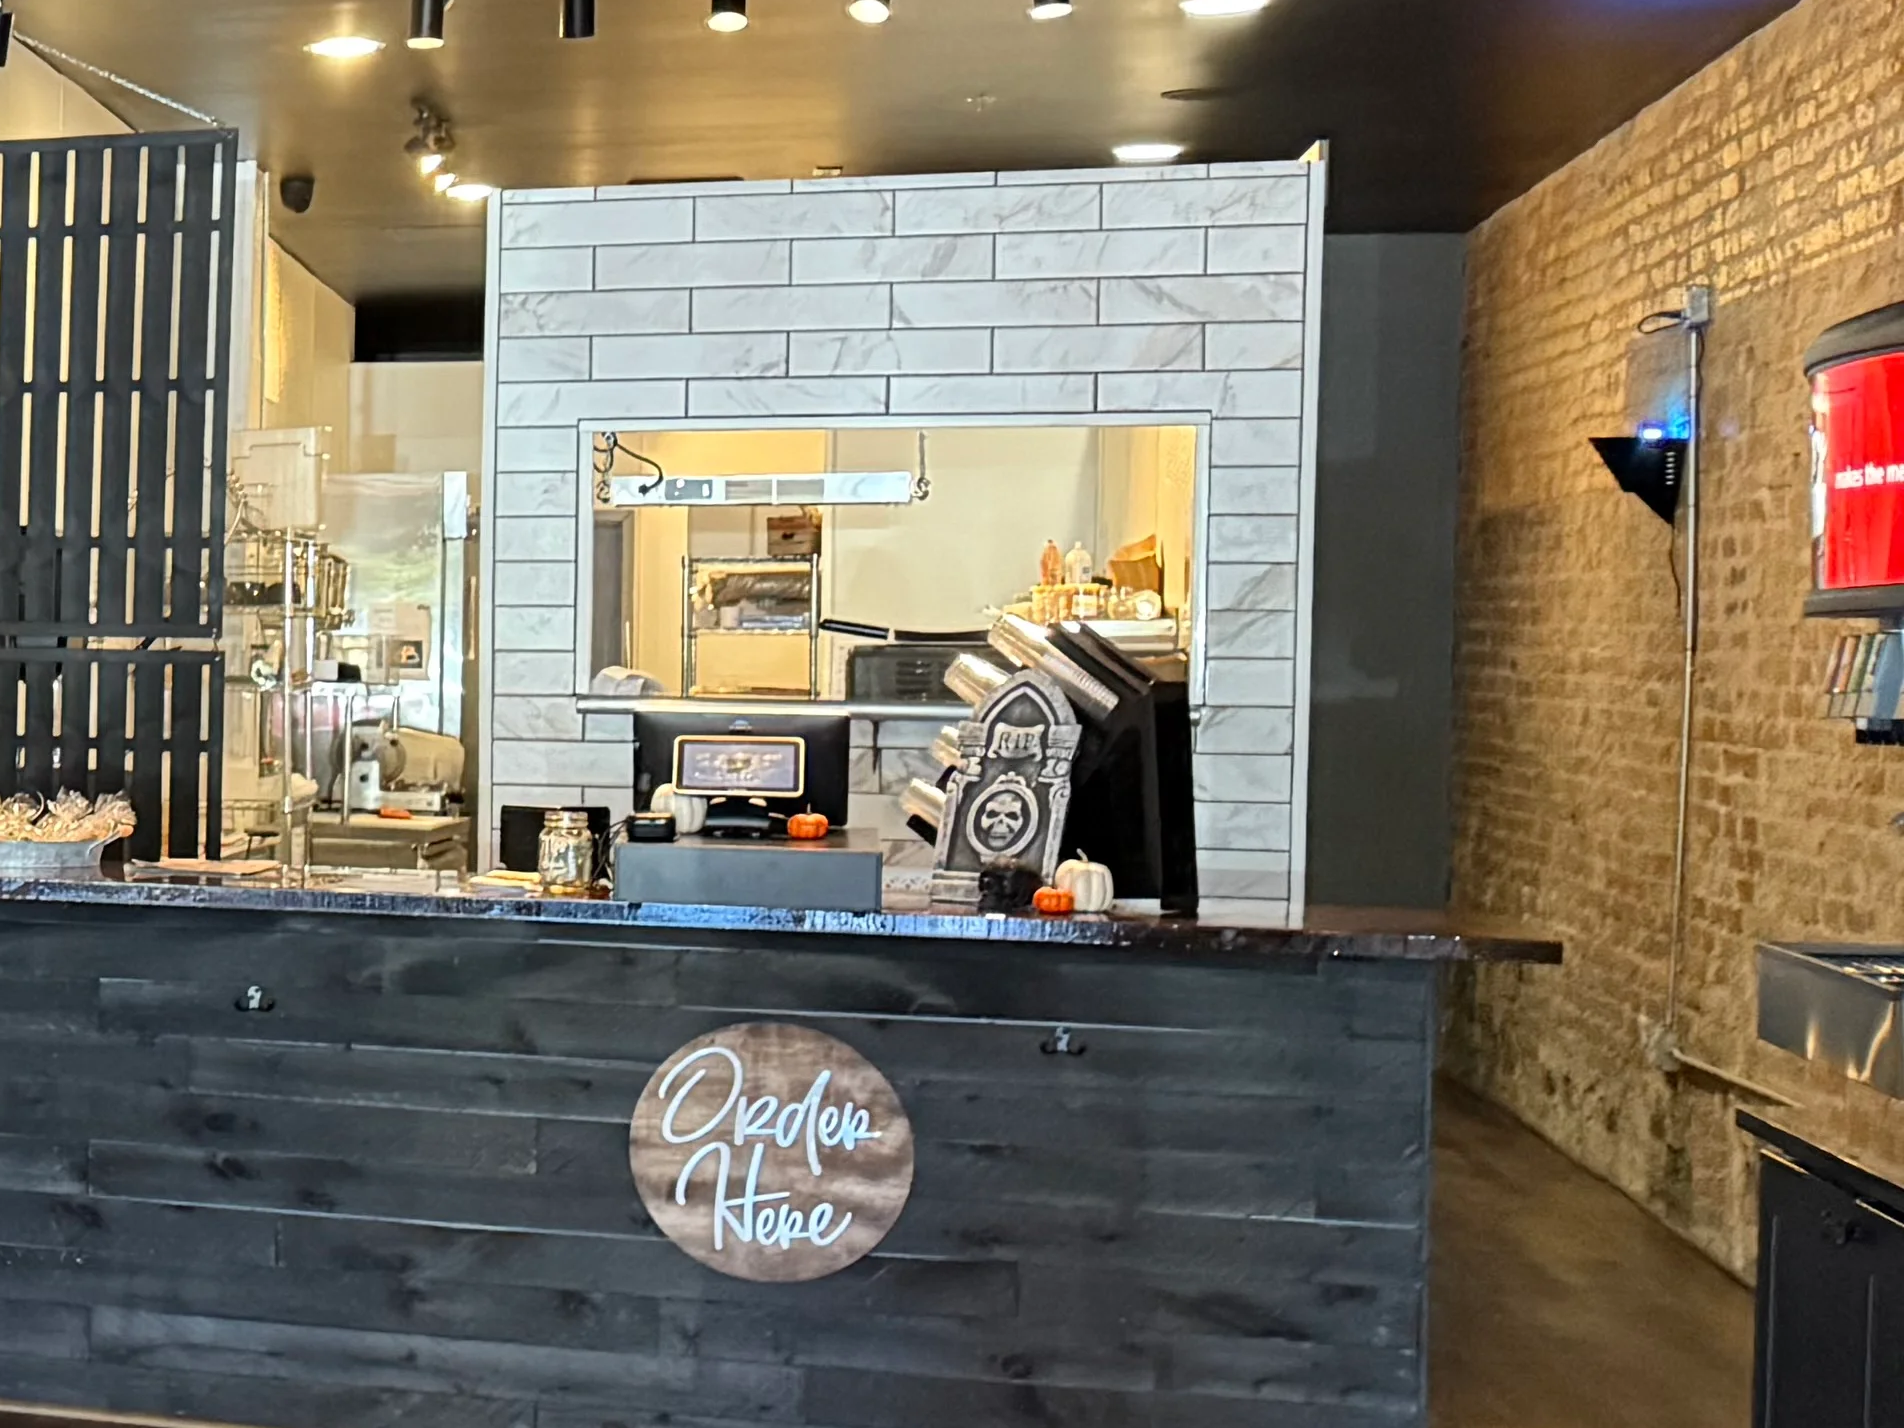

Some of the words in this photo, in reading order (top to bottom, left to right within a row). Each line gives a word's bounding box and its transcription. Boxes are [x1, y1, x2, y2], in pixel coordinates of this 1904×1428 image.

[1865, 460, 1885, 486] the
[658, 1046, 882, 1176] Order
[675, 1141, 852, 1251] Here
